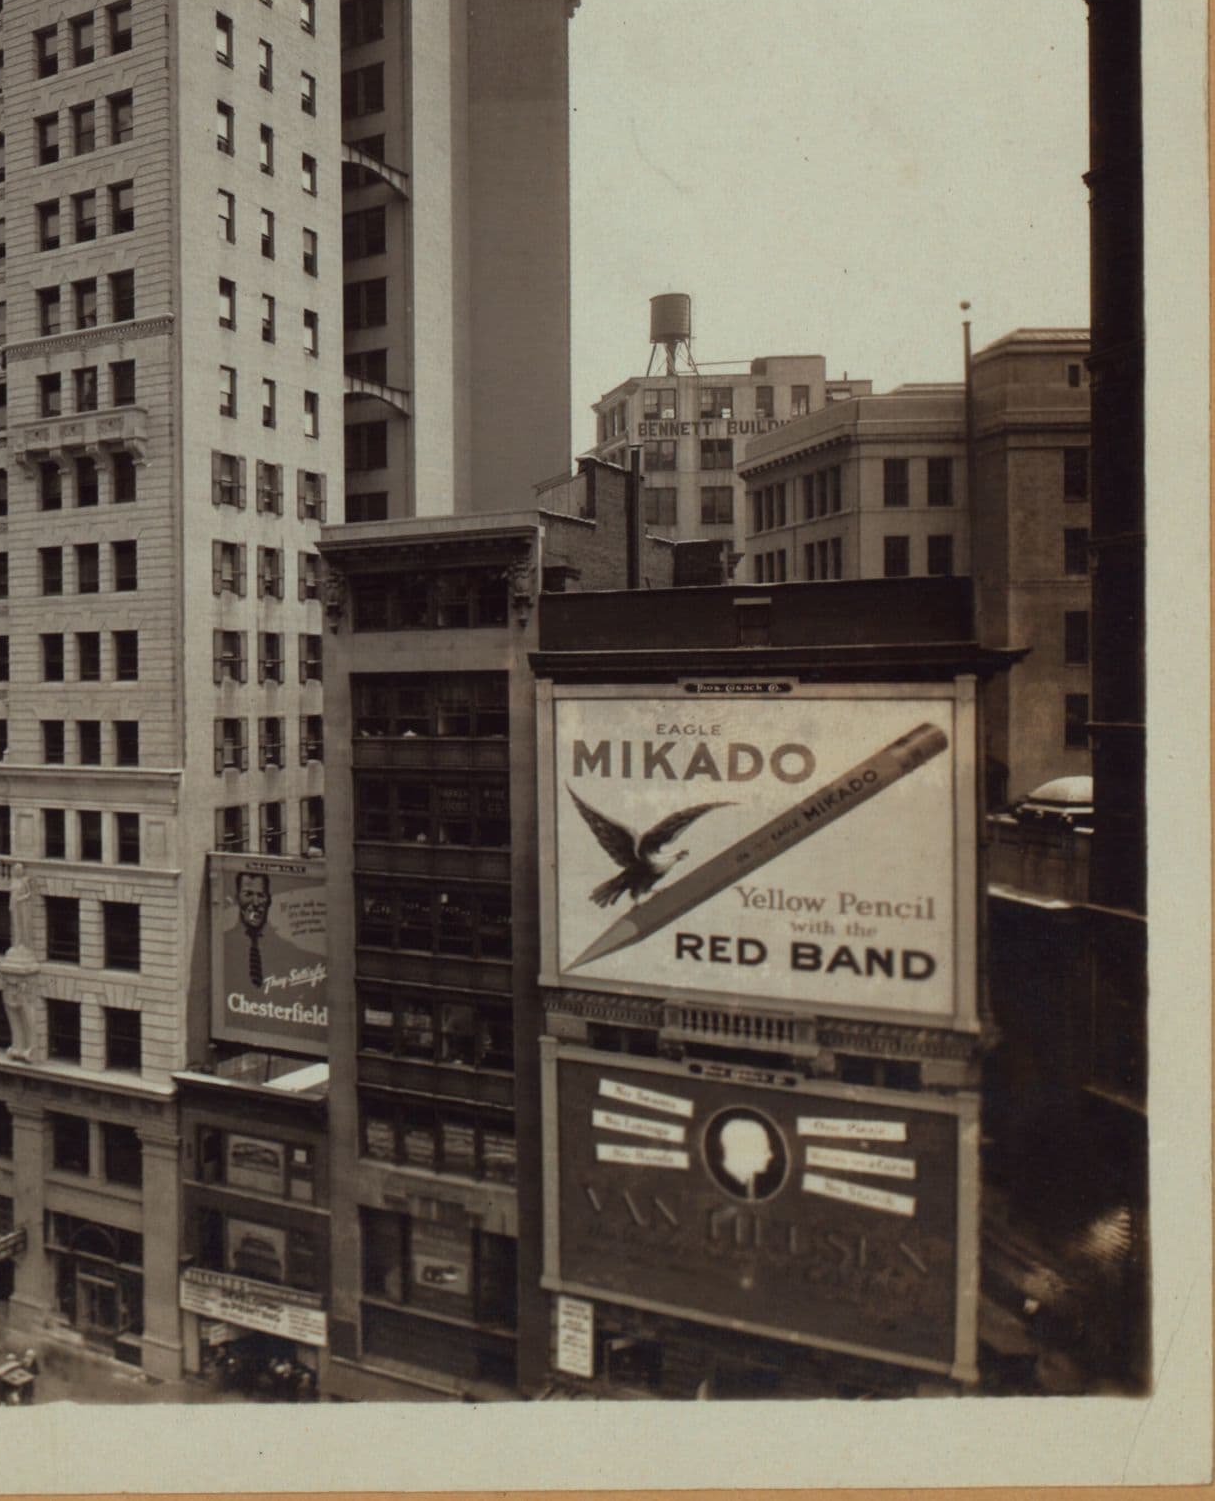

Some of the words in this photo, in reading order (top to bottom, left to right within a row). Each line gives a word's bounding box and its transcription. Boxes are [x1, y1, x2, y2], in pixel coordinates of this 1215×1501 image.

[638, 421, 713, 437] BENNETT
[656, 723, 722, 736] EAGLE
[573, 740, 816, 785] MIKADO
[803, 769, 878, 822] MIKADO
[735, 886, 825, 913] Yellow
[838, 891, 935, 921] Pencil
[790, 920, 836, 936] with
[845, 921, 877, 938] the
[675, 933, 768, 966] RED
[791, 942, 936, 981] BAND
[227, 992, 329, 1026] Chesterfield
